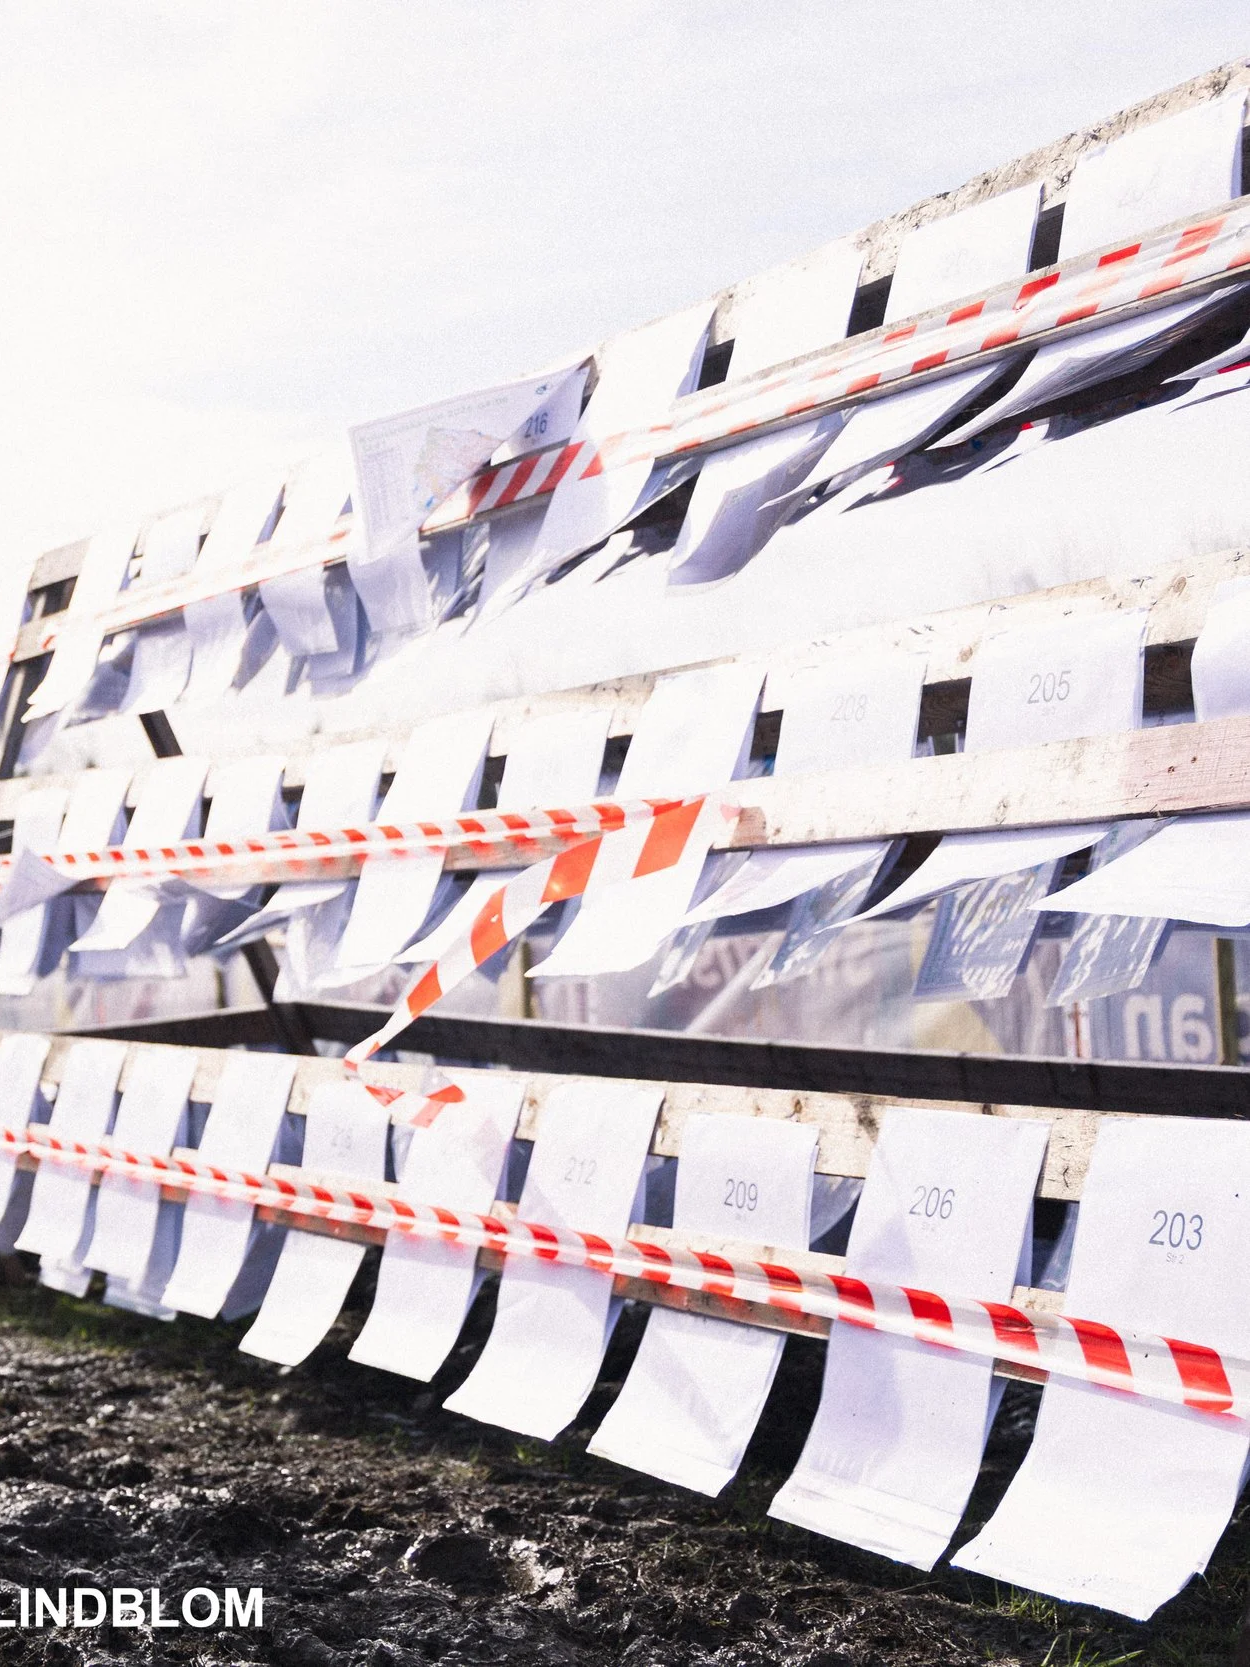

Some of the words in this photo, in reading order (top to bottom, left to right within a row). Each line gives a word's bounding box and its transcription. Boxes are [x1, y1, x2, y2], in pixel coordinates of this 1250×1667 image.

[524, 413, 548, 439] 216
[1027, 671, 1071, 704] 205
[565, 1156, 596, 1186] 212
[723, 1178, 759, 1213] 209
[909, 1185, 956, 1220] 206
[1148, 1210, 1205, 1252] 203
